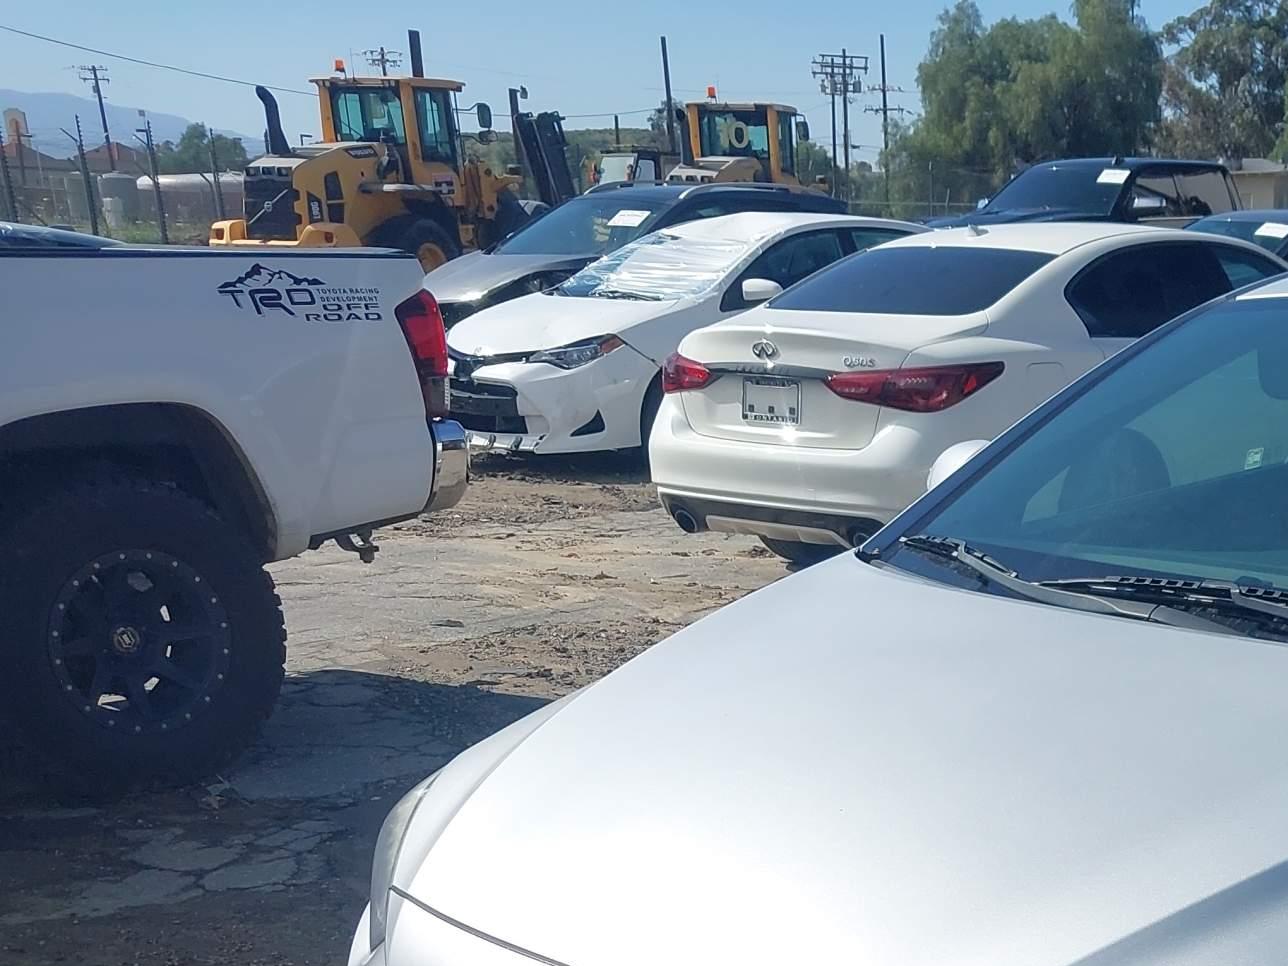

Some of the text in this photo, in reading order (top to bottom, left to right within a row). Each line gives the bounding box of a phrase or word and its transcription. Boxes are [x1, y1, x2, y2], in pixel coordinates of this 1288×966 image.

[217, 288, 316, 316] TRD
[320, 295, 379, 303] DEVELOPMENT
[322, 303, 380, 312] OFF
[305, 313, 383, 322] ROAD
